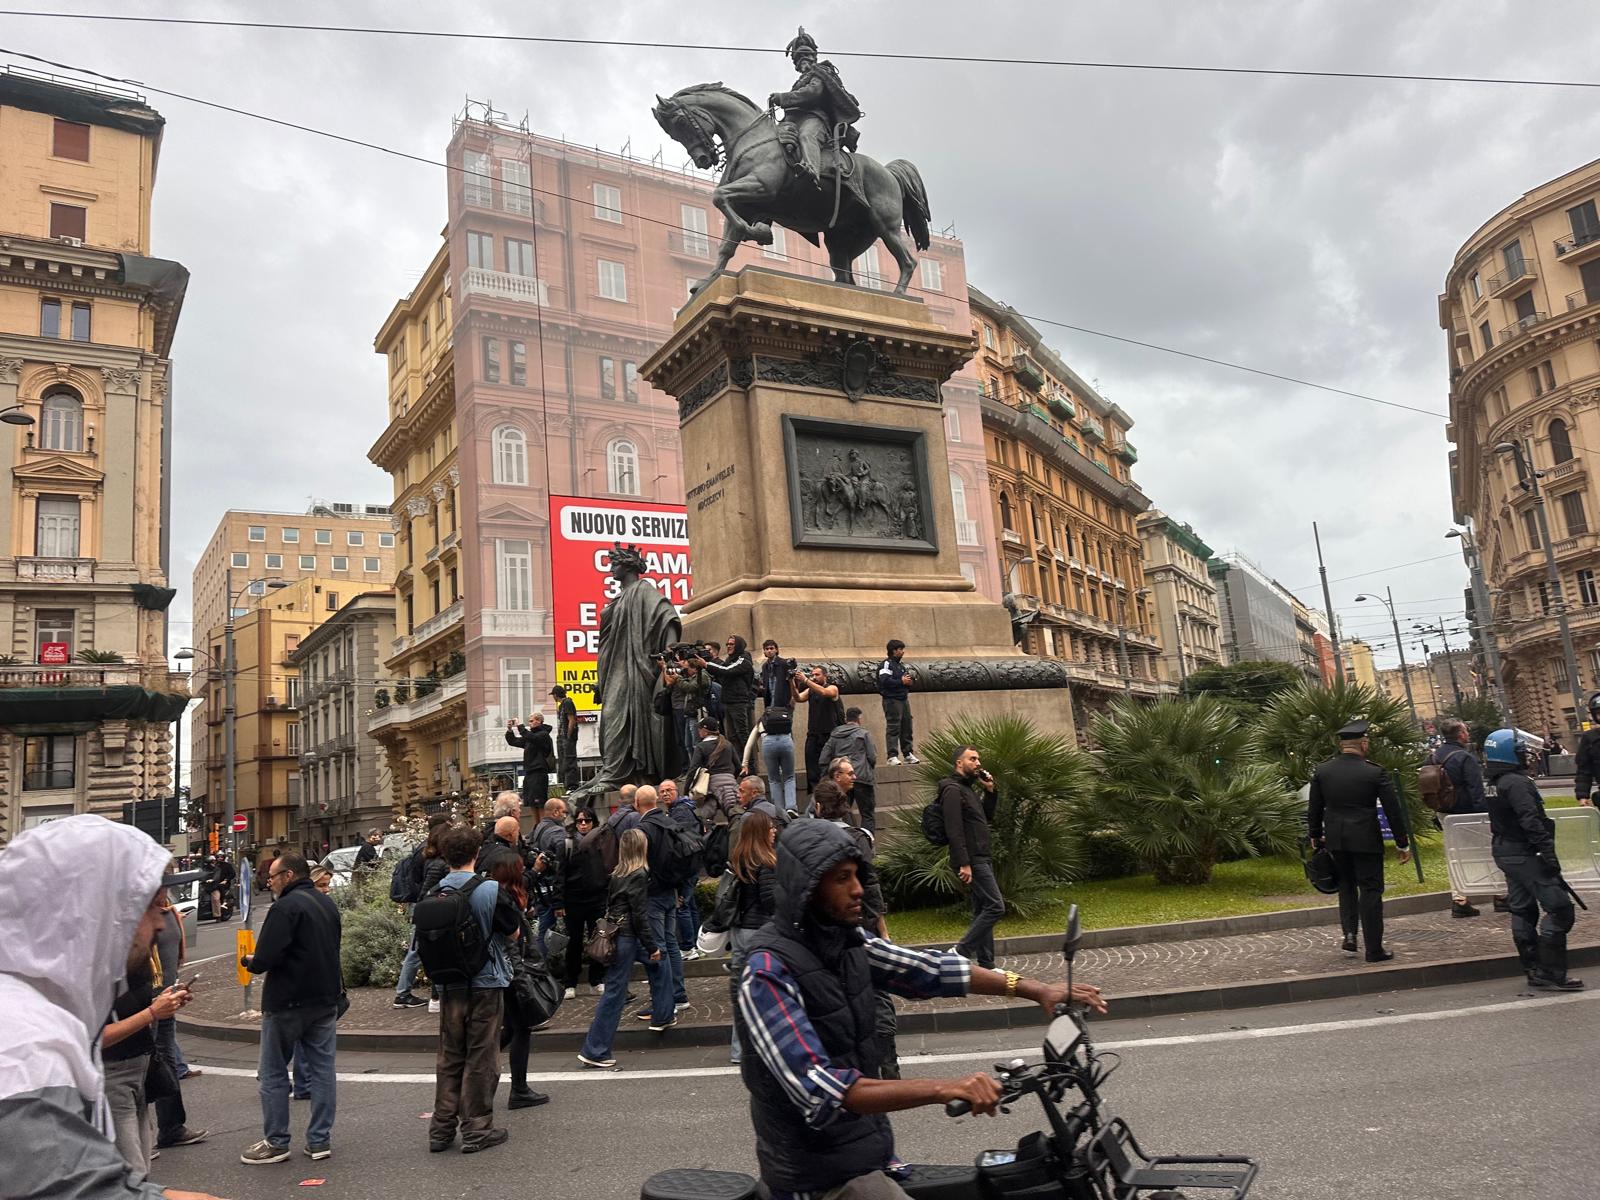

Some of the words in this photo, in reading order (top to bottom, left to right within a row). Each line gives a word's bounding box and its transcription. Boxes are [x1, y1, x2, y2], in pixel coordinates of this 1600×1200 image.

[570, 511, 626, 536] NUOVO
[580, 603, 598, 626] E
[563, 670, 578, 681] IN
